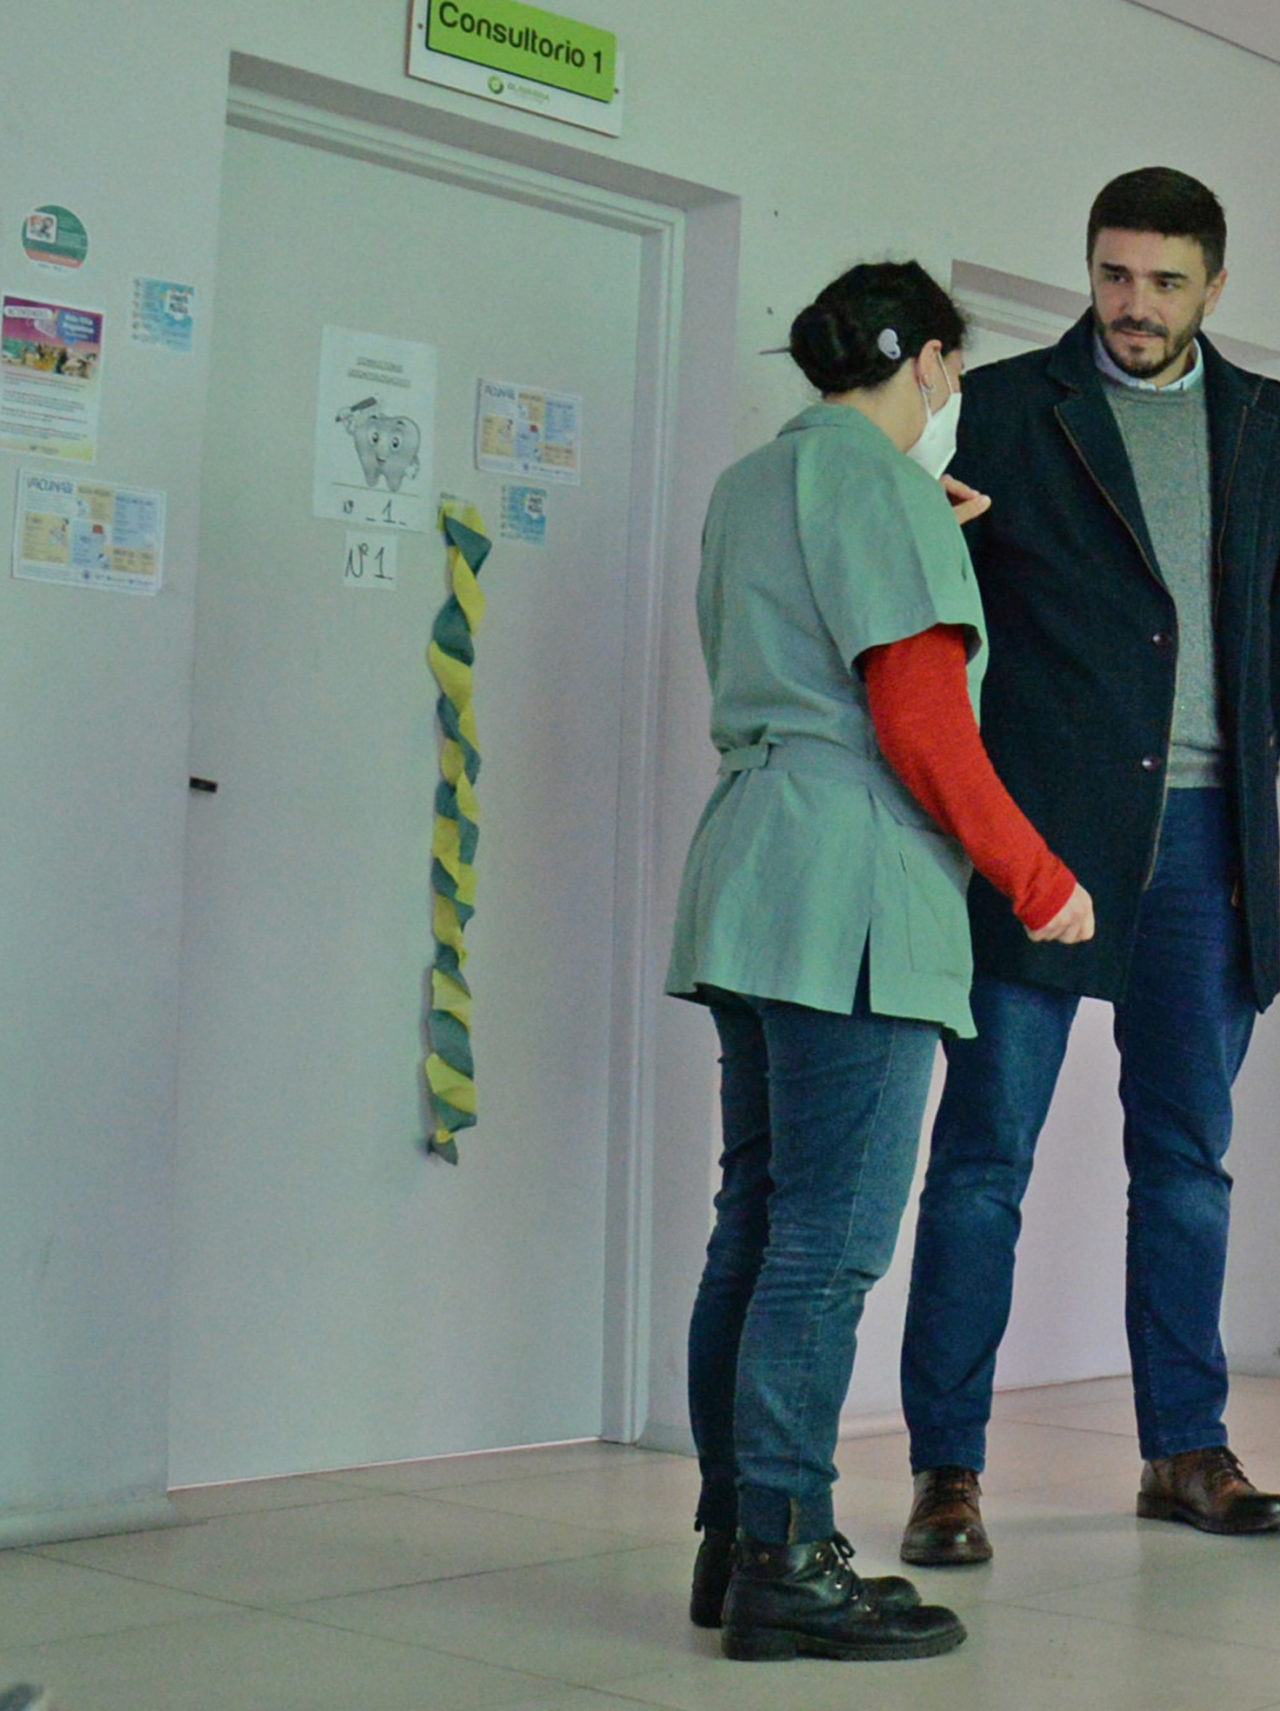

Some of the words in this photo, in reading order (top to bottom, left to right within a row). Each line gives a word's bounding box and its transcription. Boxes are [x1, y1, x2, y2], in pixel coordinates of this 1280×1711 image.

[439, 1, 585, 68] Consultorio
[593, 50, 603, 74] 1
[374, 546, 395, 580] 1
